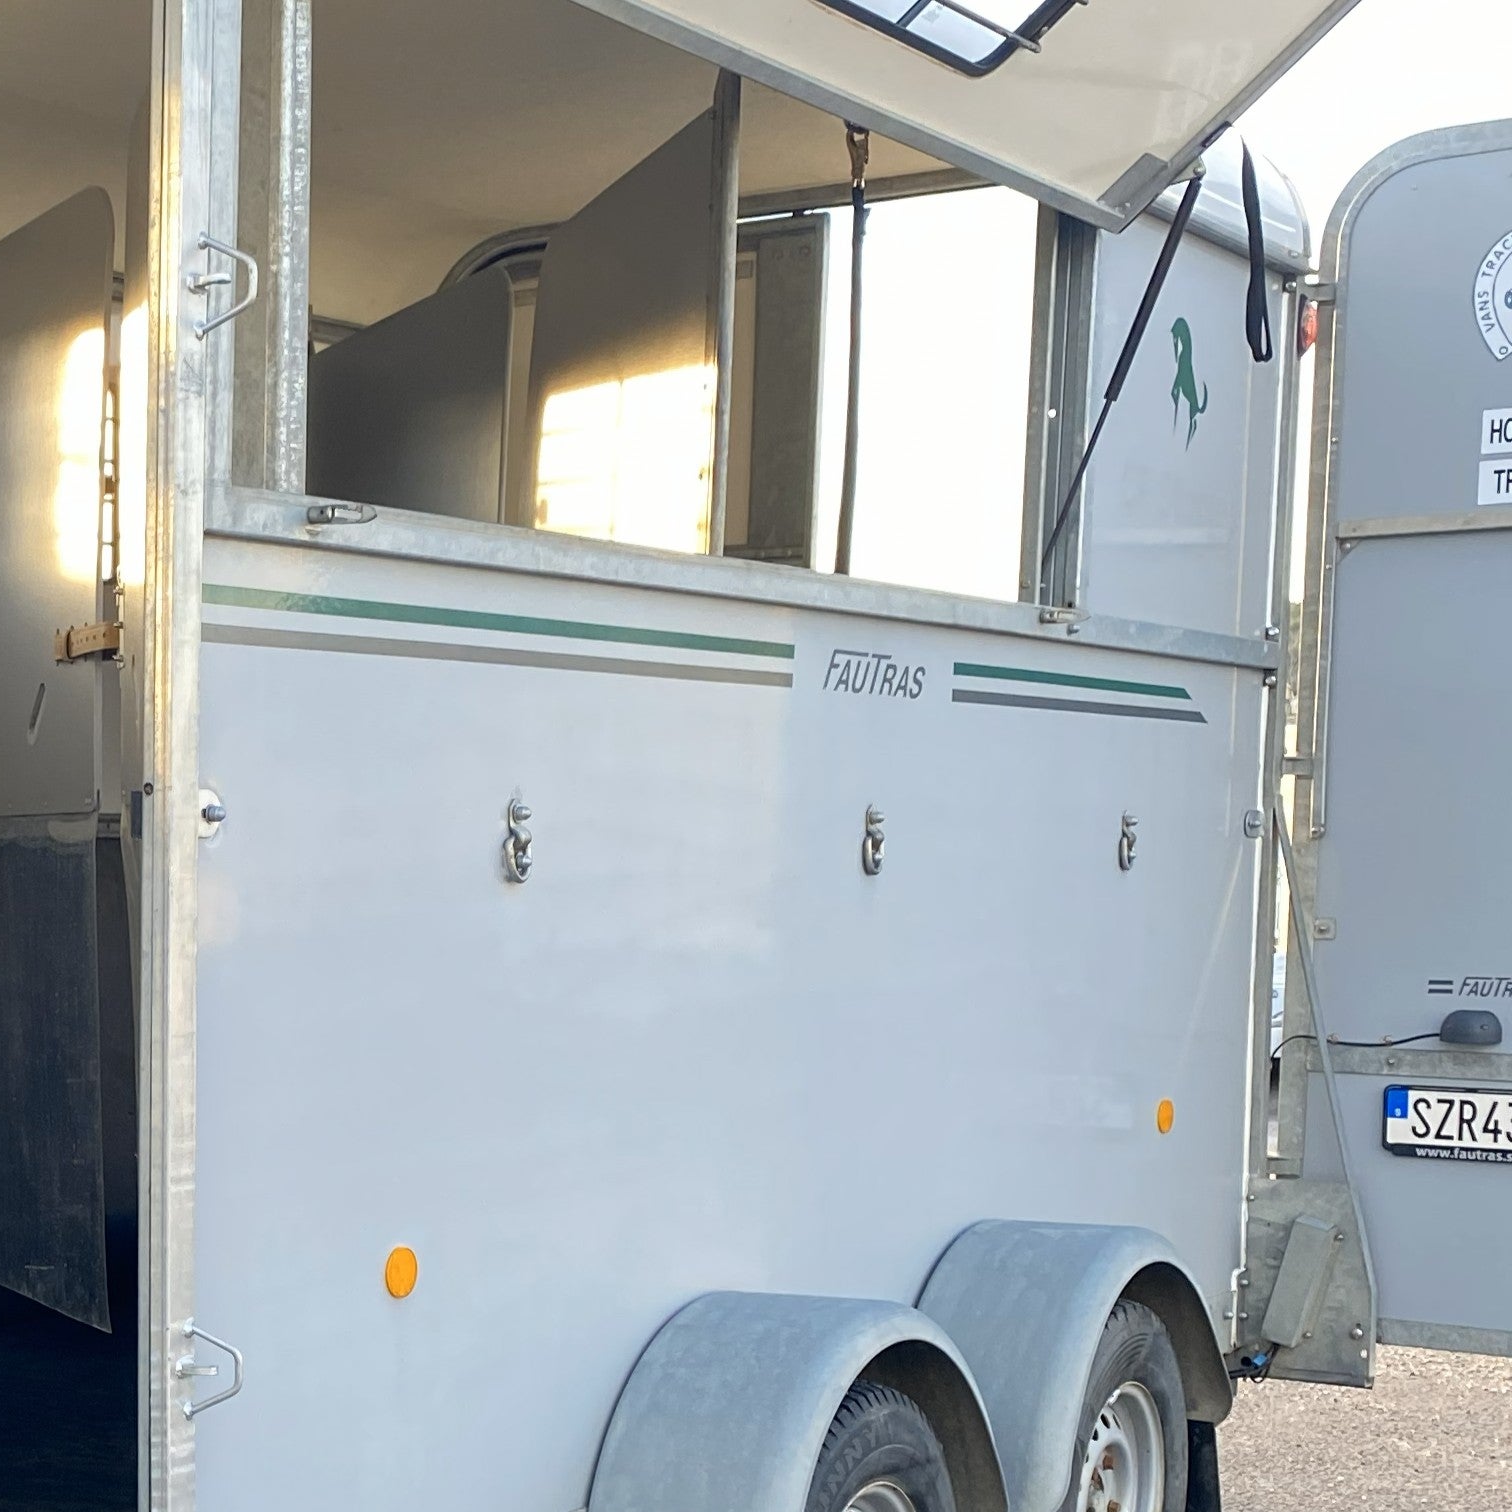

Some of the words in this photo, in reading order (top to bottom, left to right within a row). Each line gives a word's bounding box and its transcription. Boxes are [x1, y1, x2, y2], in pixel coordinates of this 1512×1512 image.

[1481, 234, 1512, 279] TRAC
[1477, 291, 1496, 334] VANS
[823, 649, 926, 699] FAUTRAS
